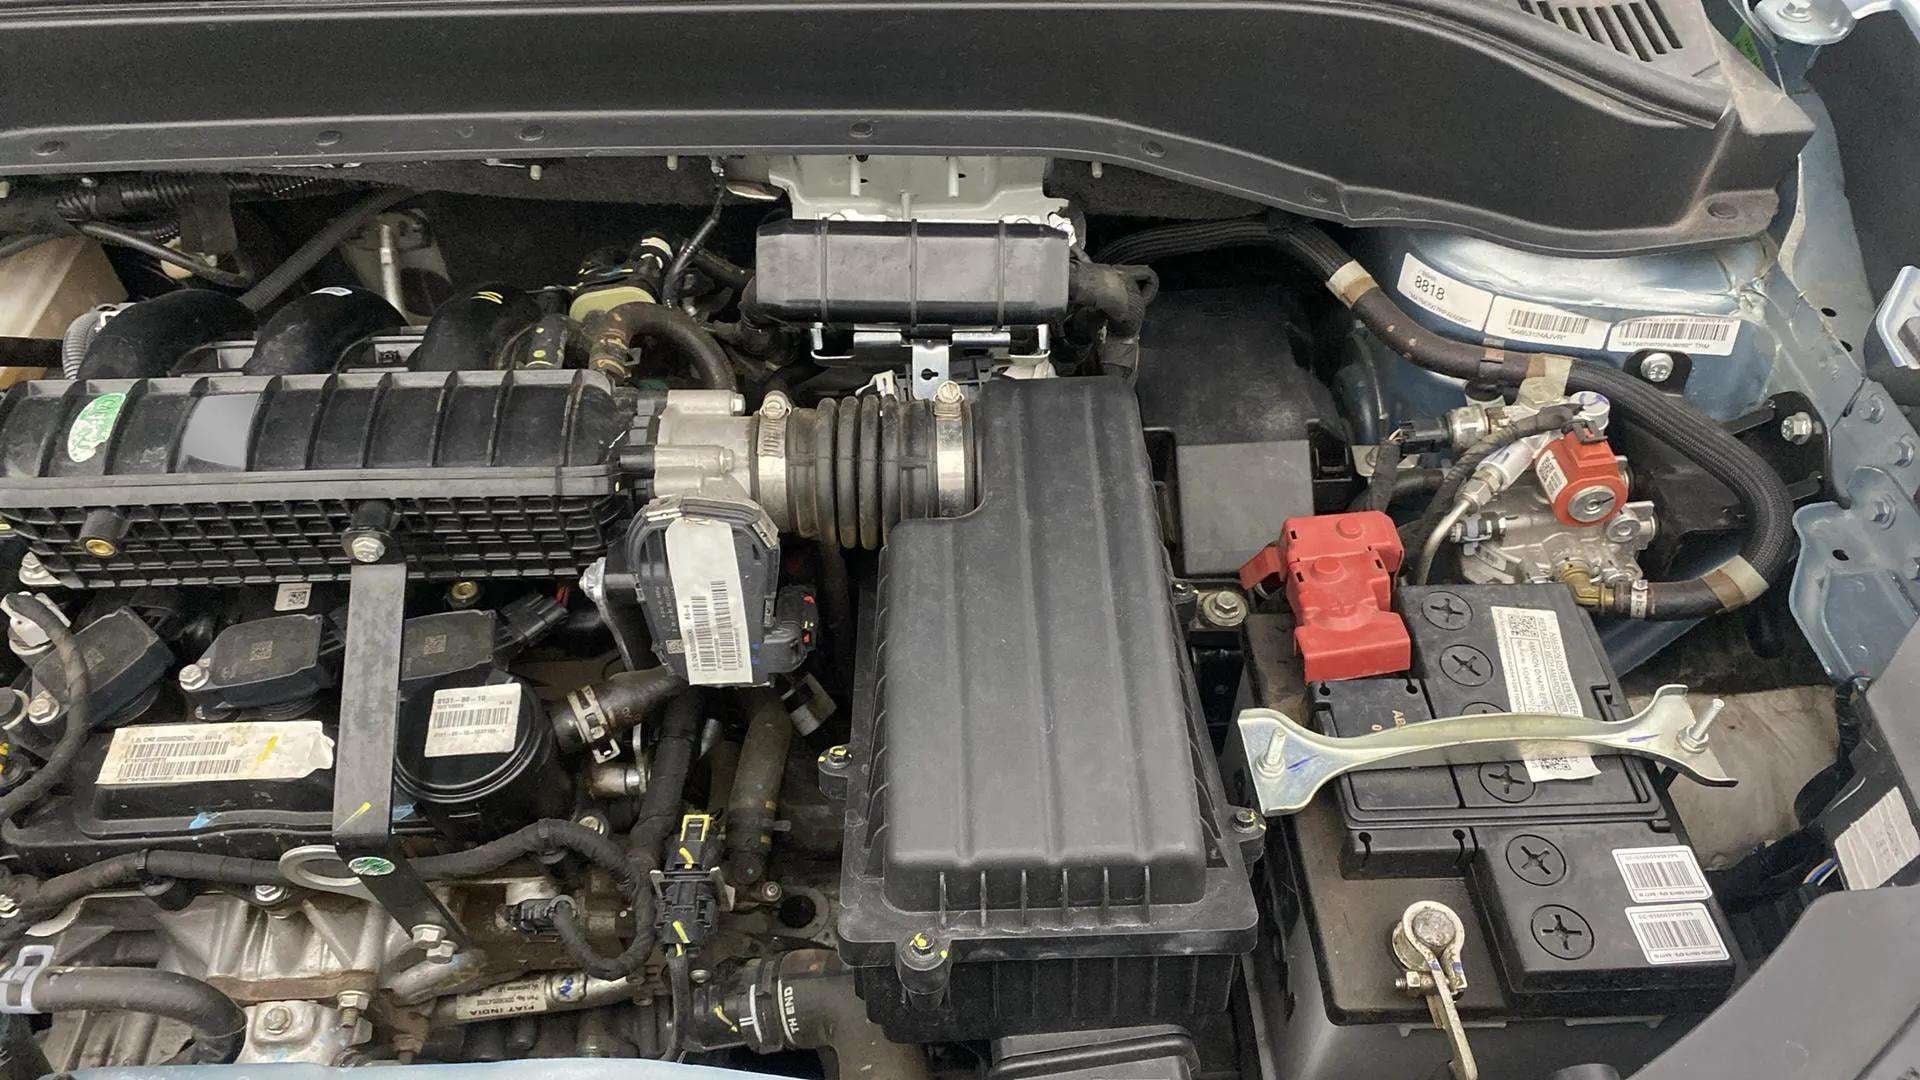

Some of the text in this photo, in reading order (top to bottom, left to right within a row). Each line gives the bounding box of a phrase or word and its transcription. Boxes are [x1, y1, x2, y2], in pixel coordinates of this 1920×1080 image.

[1415, 275, 1445, 300] 8818
[469, 1004, 535, 1016] FIAT INDIA
[787, 1017, 800, 1034] TH
